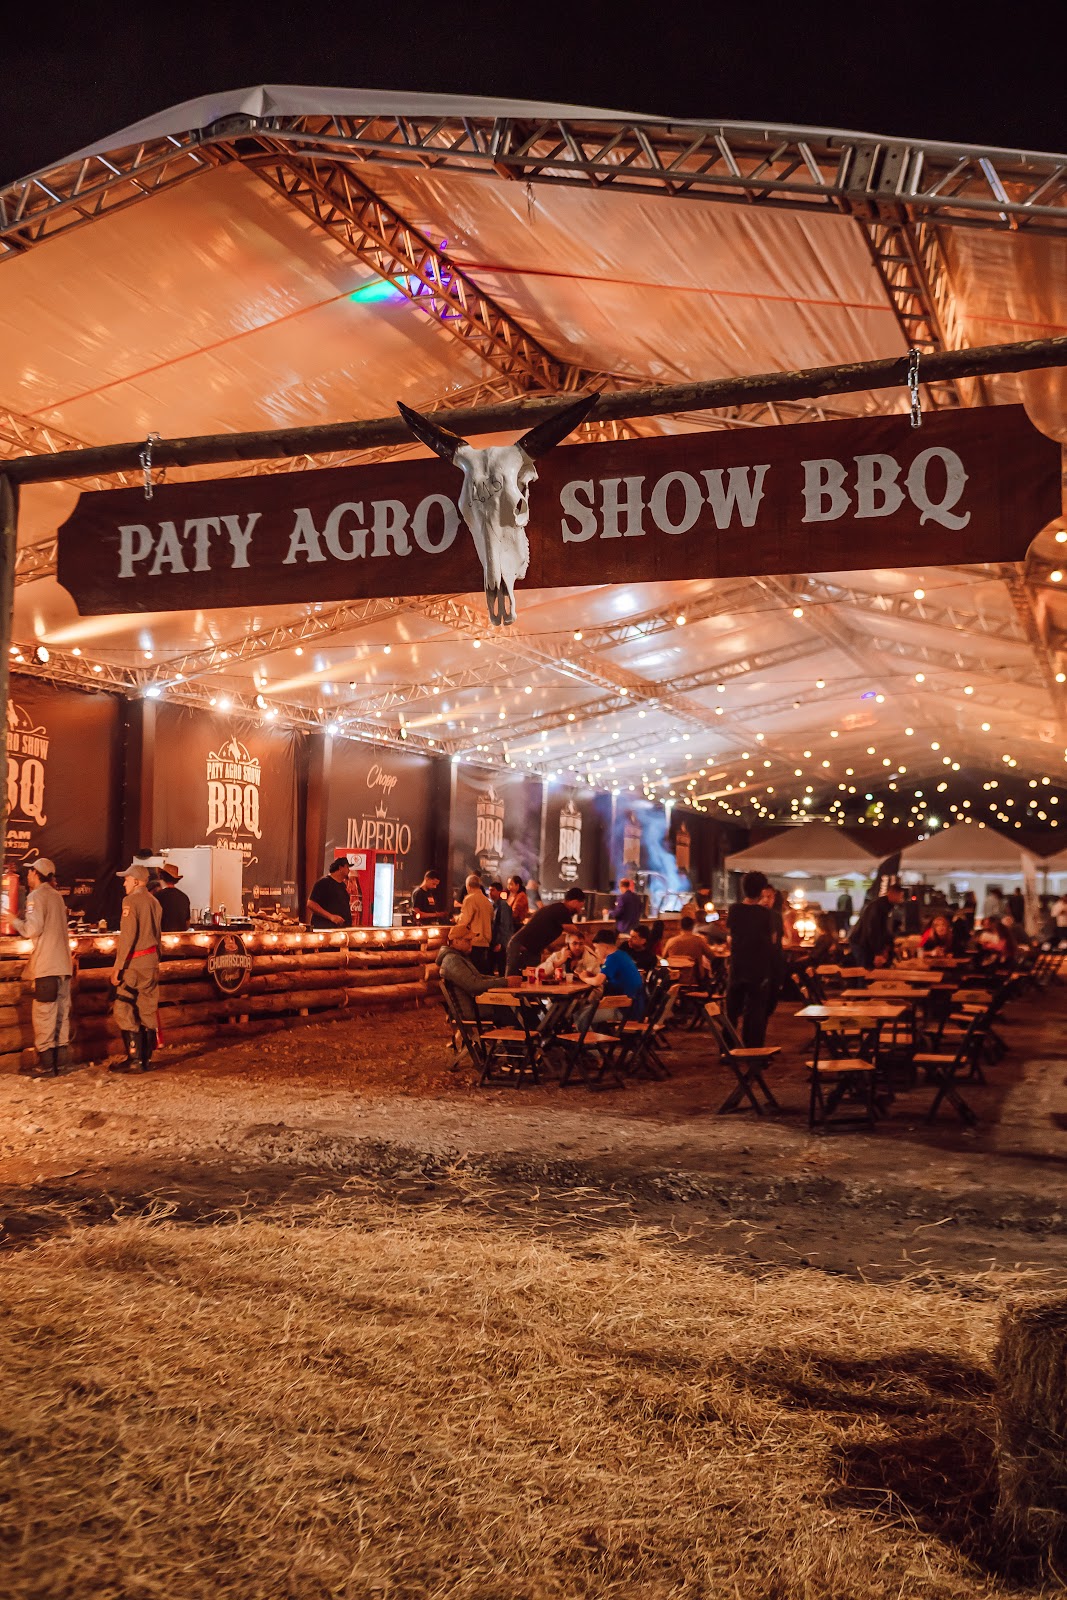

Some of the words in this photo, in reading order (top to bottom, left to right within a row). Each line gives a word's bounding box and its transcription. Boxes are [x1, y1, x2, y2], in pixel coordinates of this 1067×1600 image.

[117, 512, 262, 579] PATY
[282, 493, 462, 566] AGRO
[559, 464, 771, 544] SHOW
[801, 446, 972, 531] BBQ
[6, 732, 20, 752] RO
[22, 735, 49, 760] SHOW
[207, 763, 223, 780] PATY
[225, 763, 242, 780] AGRO
[243, 766, 261, 786] SHOW
[366, 764, 398, 795] Chopp
[7, 758, 47, 826] BQ
[206, 781, 262, 839] BBQ
[6, 830, 31, 839] AM
[229, 842, 252, 851] RAM
[475, 817, 503, 858] BBQ
